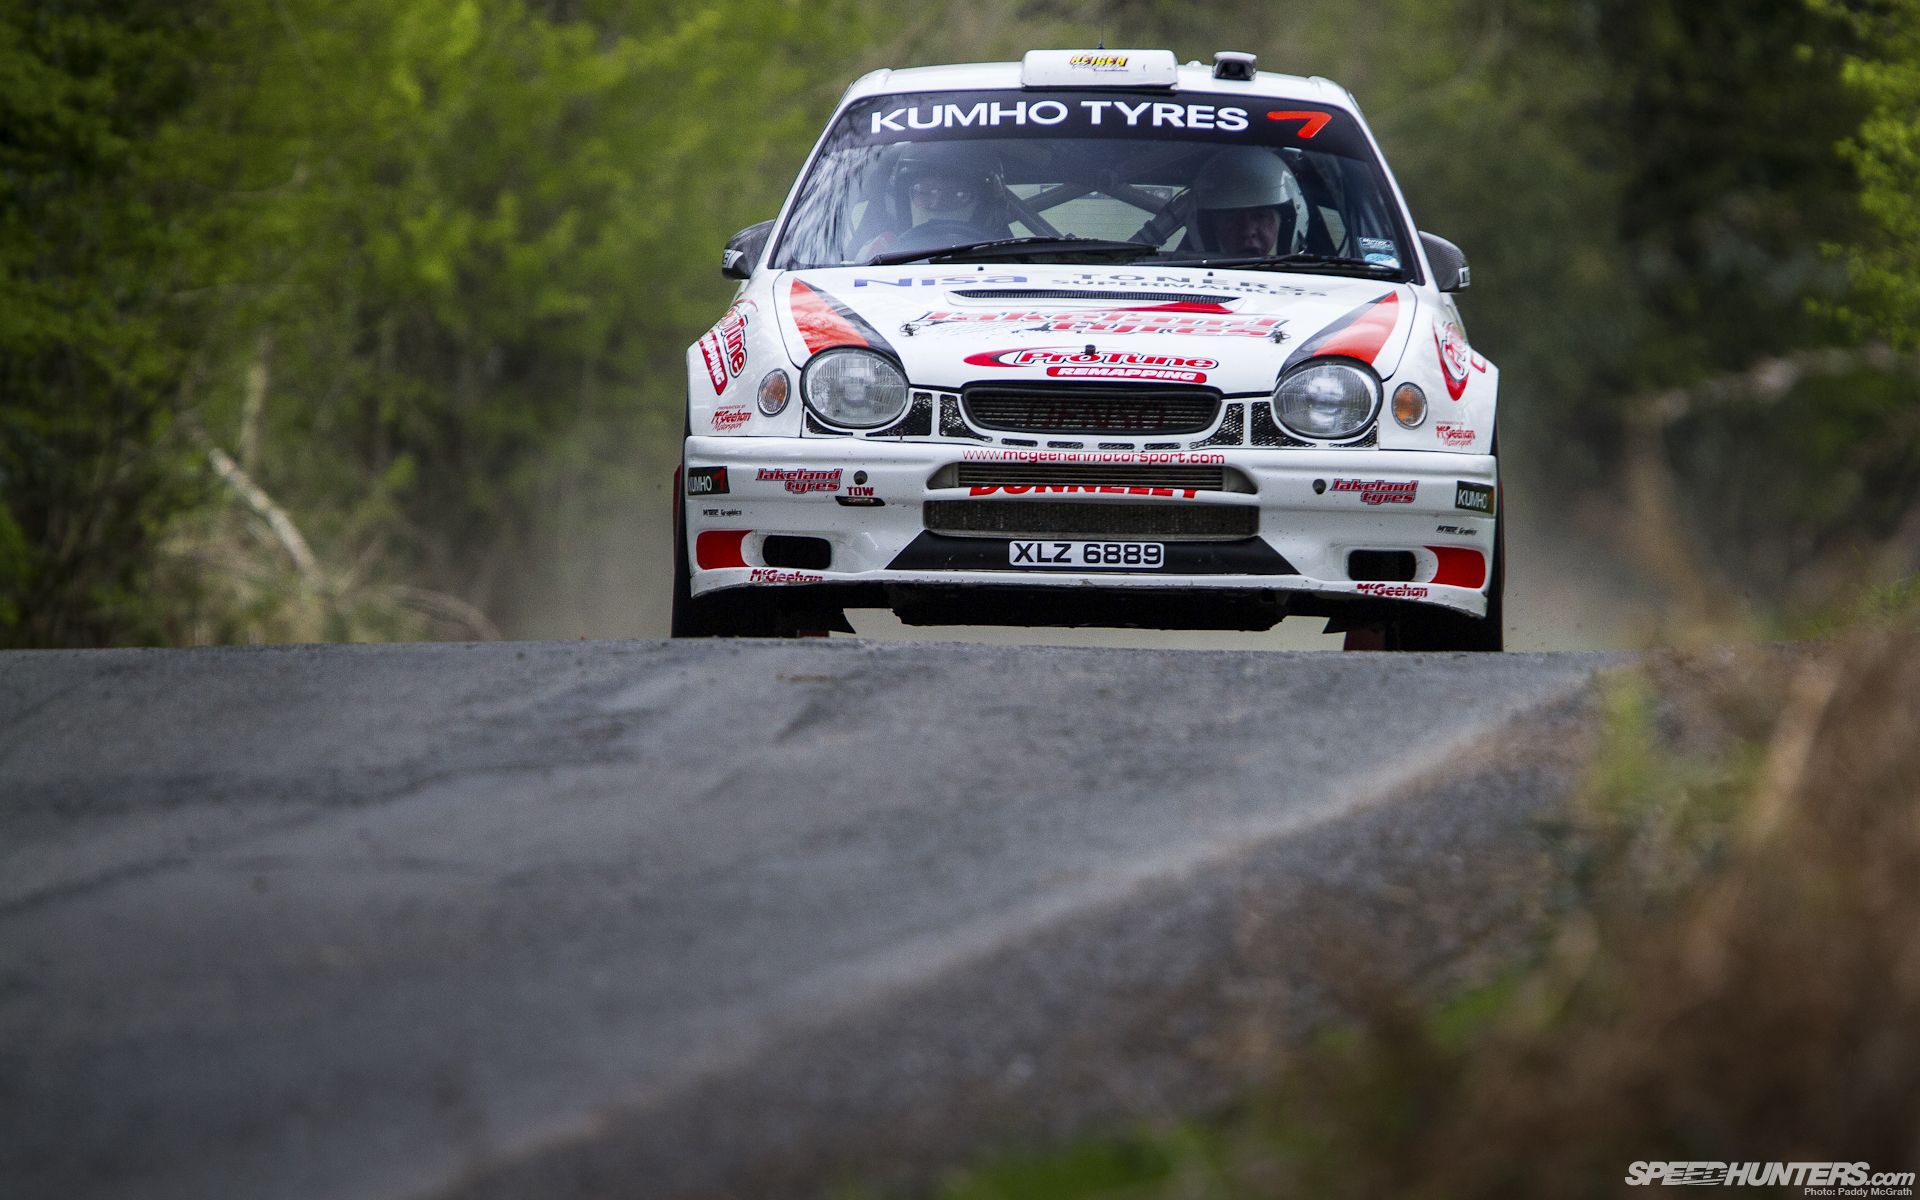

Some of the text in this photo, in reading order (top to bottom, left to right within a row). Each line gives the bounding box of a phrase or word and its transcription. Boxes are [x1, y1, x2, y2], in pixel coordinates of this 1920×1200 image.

[871, 100, 1249, 134] KUMHO TYRES
[854, 275, 1028, 287] Nisa
[1014, 350, 1219, 369] ProTune
[1057, 366, 1198, 381] REMAPPING
[962, 449, 1226, 465] www.mcgeehanmotorsport.com
[688, 475, 713, 493] KUMHO
[785, 480, 841, 494] tyres
[847, 486, 874, 496] TOW
[1361, 490, 1417, 505] tyres
[1458, 489, 1488, 509] KUMHO
[1013, 543, 1162, 565] XLZ 6889
